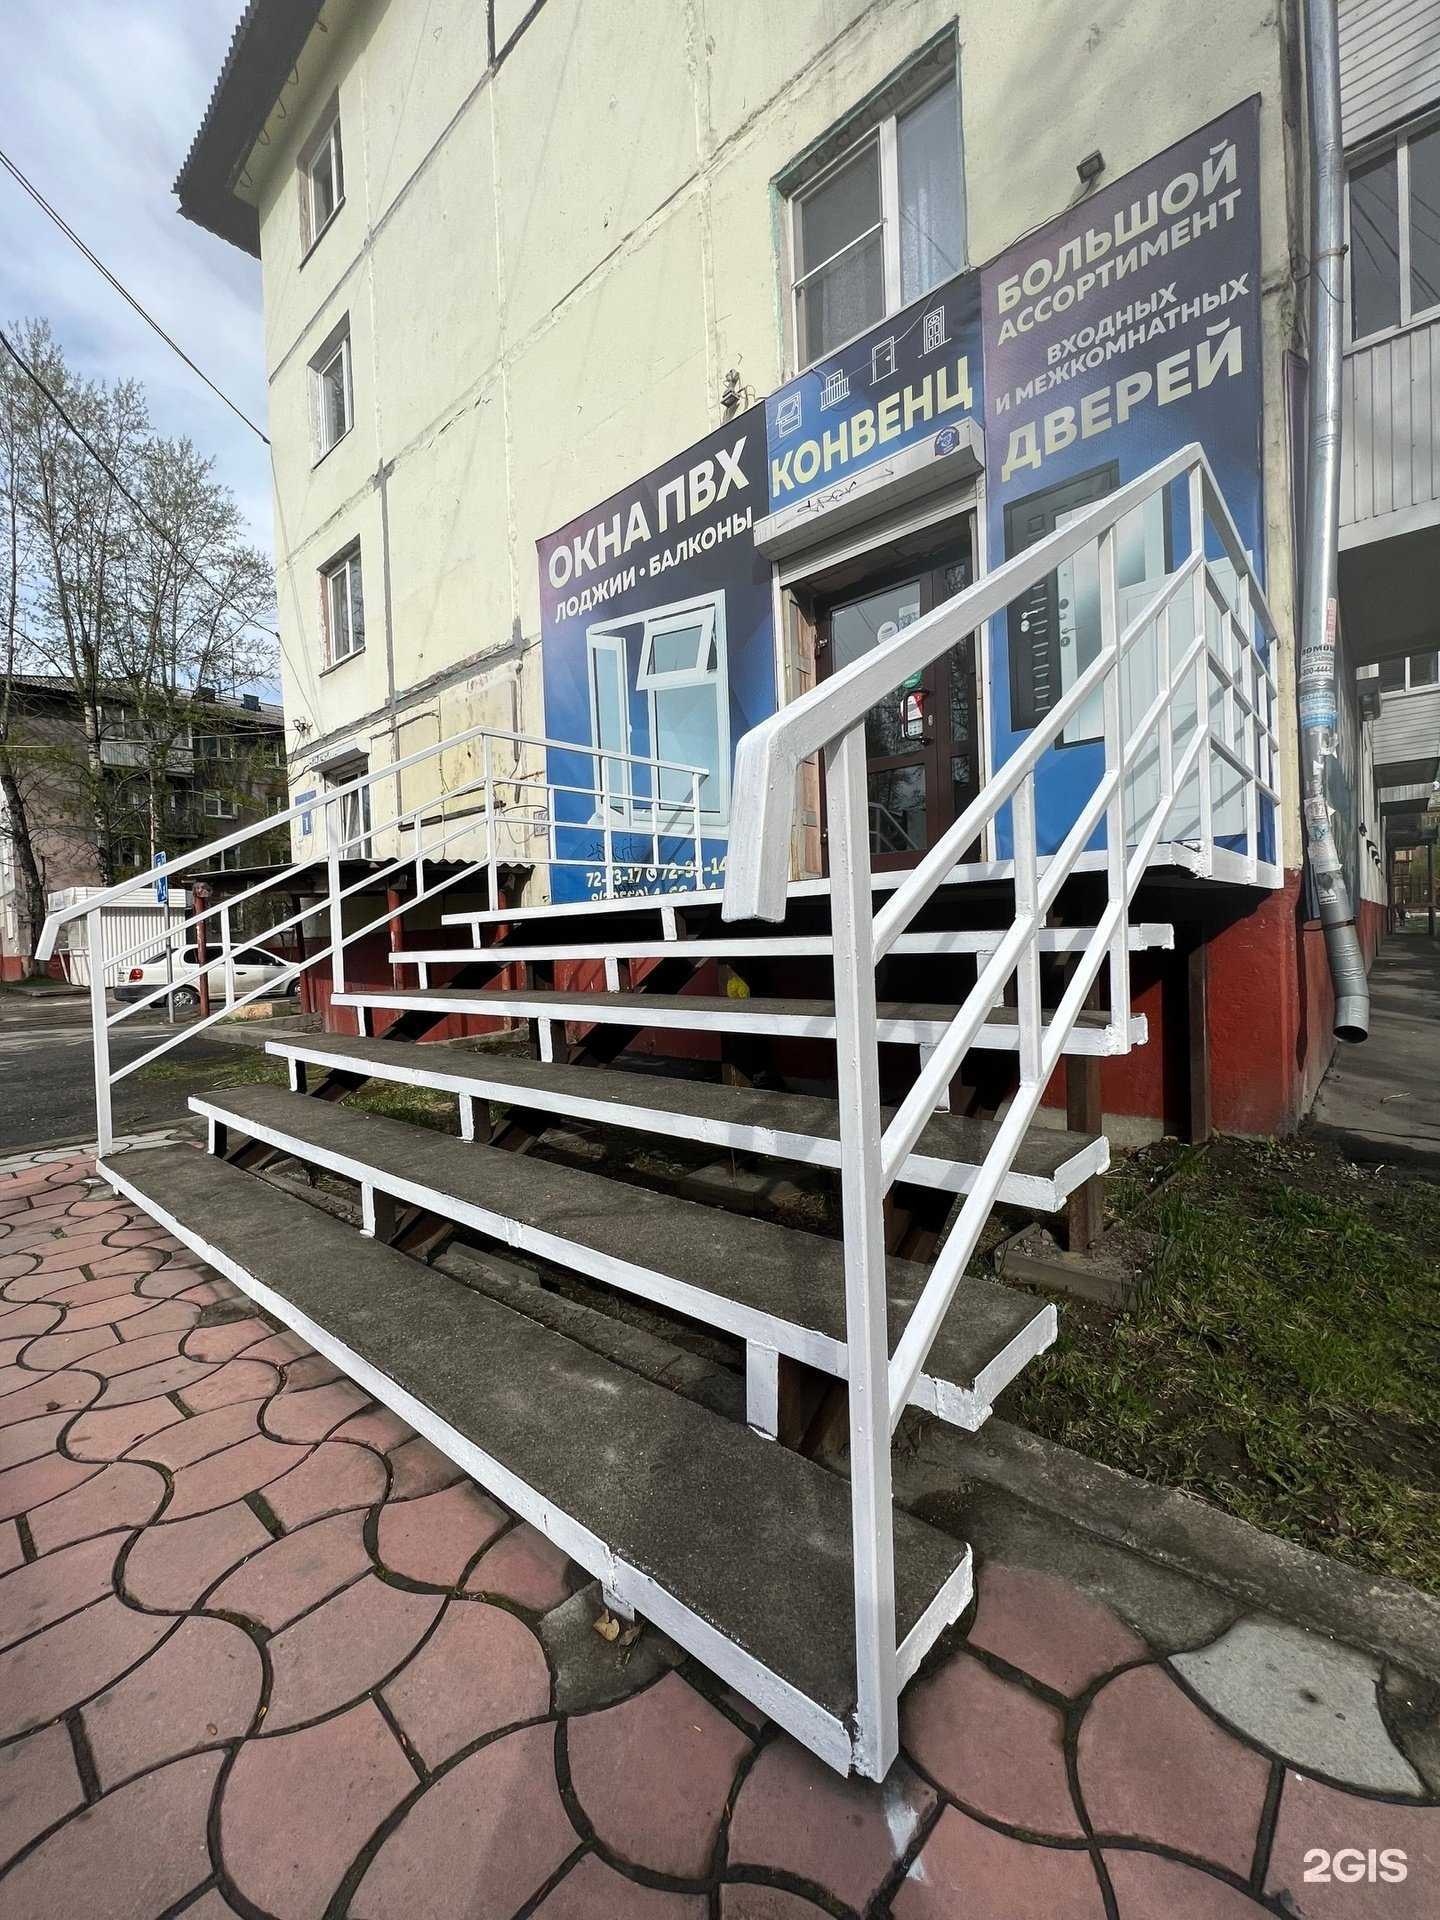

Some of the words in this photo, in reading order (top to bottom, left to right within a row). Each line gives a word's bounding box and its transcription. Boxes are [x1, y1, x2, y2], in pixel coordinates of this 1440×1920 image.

[997, 138, 1238, 314] БОЛЬШОЙ
[998, 188, 1242, 346] АССОРТИМЕНТ
[995, 393, 1011, 416] И
[1015, 272, 1251, 406] МЕЖКОМНАТНЫХ
[1047, 281, 1178, 365] ВХОДНЫХ
[771, 355, 974, 498] КОНВЕНЦ
[1001, 317, 1243, 482] ДВЕРЕЙ
[548, 502, 651, 589] ОКНА
[657, 435, 750, 534] ПВХ
[554, 566, 636, 624] ЛОДЖИИ
[648, 505, 753, 576] БАЛКОНЫ
[586, 867, 642, 888] 72-3-17
